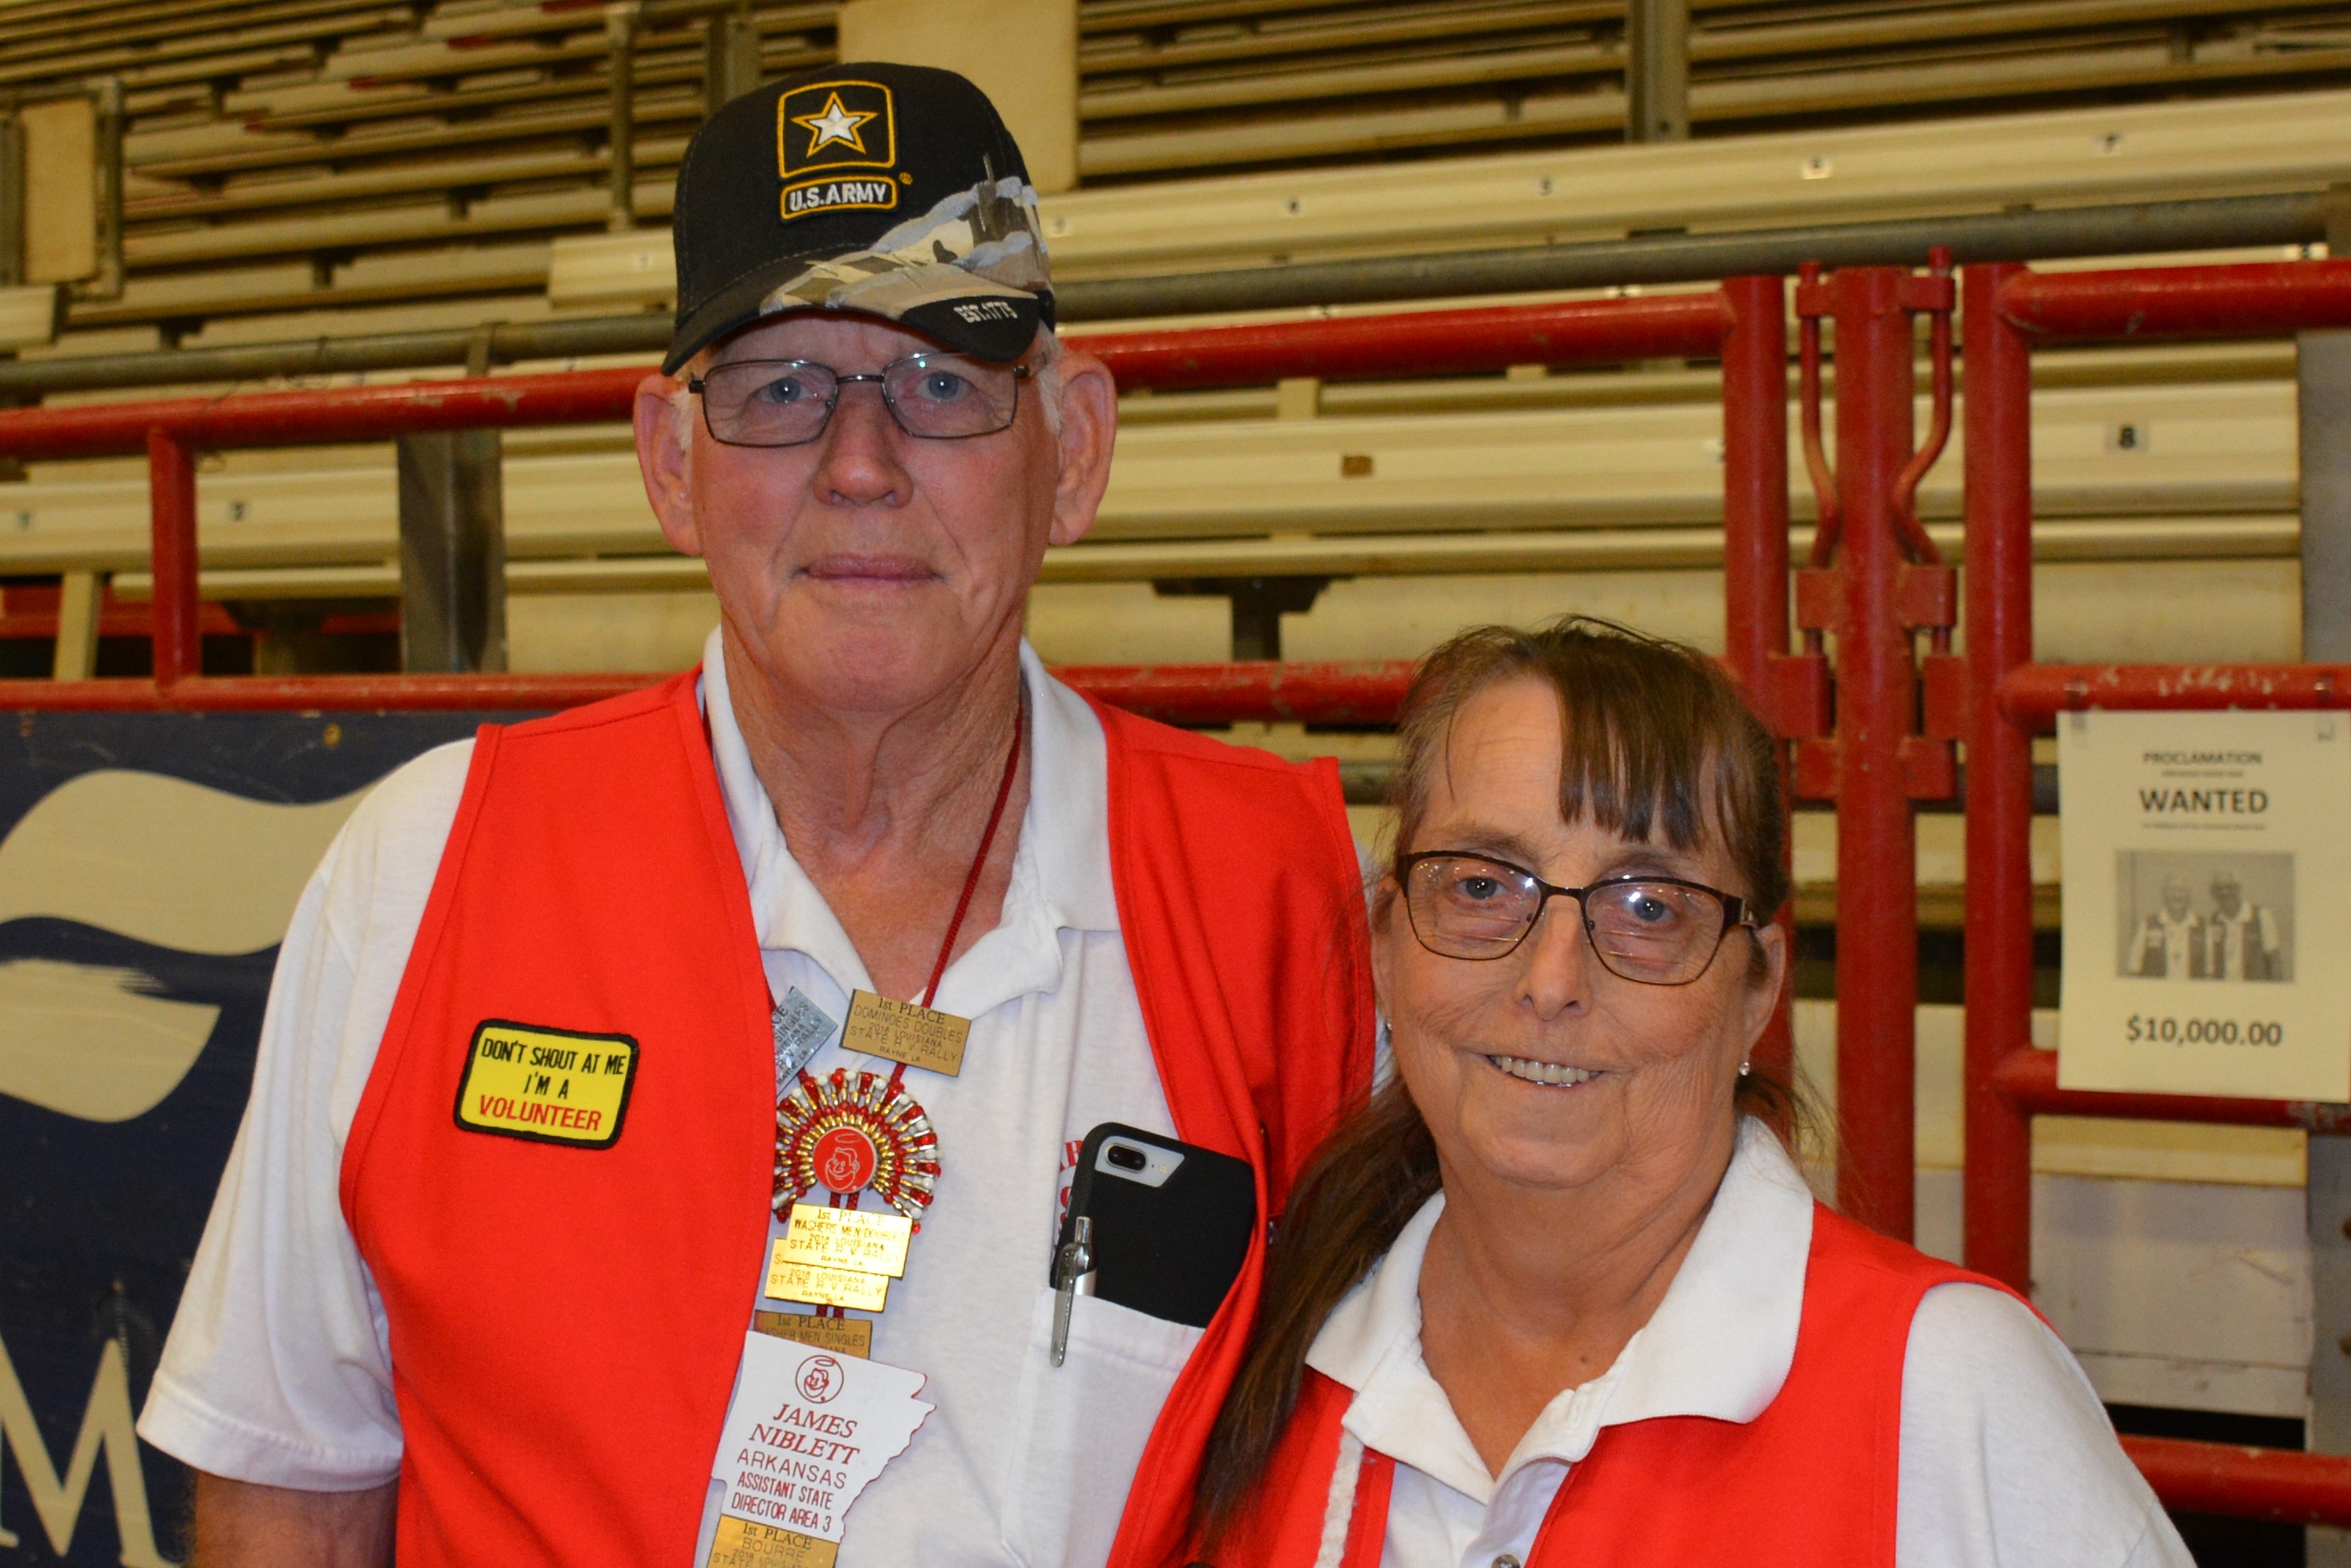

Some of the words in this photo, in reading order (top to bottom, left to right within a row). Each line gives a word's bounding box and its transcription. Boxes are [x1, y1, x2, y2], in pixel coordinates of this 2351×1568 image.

[2119, 425, 2136, 449] 8
[2143, 750, 2262, 765] PROCLAMATION
[2139, 788, 2268, 814] WANTED
[878, 998, 893, 1010] 1st
[899, 1002, 945, 1024] PLACE
[854, 1005, 909, 1029] DOMINOES
[914, 1021, 963, 1044] DOUBLES
[2127, 1015, 2283, 1046] $10,000.00
[850, 1026, 887, 1044] STATE
[921, 1045, 957, 1060] RALLY
[895, 1030, 942, 1048] LOUISIANA
[481, 1038, 527, 1063] DON'T
[529, 1047, 578, 1071] SHOUT
[581, 1053, 601, 1073] AT
[604, 1055, 627, 1075] ME
[524, 1072, 551, 1095] I'M
[558, 1079, 570, 1099] A
[480, 1095, 602, 1131] VOLUNTEER
[795, 1219, 836, 1234] WASHERS
[842, 1225, 862, 1237] MEN
[817, 1208, 831, 1220] 1st
[839, 1210, 882, 1227] PLACE
[790, 1239, 828, 1253] STATE
[809, 1233, 830, 1245] 2018
[836, 1238, 885, 1251] LOUISIANA
[771, 1274, 809, 1288] STATE
[816, 1281, 825, 1290] R
[831, 1282, 839, 1291] V
[844, 1283, 882, 1297] RALLY
[790, 1269, 811, 1280] 2018
[816, 1273, 866, 1284] LOUISIANA
[798, 1317, 845, 1331] PLACE
[800, 1330, 820, 1343] MEN
[825, 1333, 866, 1347] SINGLES
[773, 1403, 858, 1438] JAMES
[749, 1424, 860, 1465] NIBLETT
[737, 1448, 847, 1489] ARKANSAS
[738, 1471, 796, 1500] ASSISTANT
[799, 1485, 834, 1510] STATE
[731, 1492, 787, 1520] DIRECTOR
[789, 1507, 819, 1530] AREA
[823, 1515, 832, 1533] 3
[742, 1537, 805, 1562] BOURRE
[743, 1523, 757, 1536] 1st
[765, 1527, 812, 1550] PLACE
